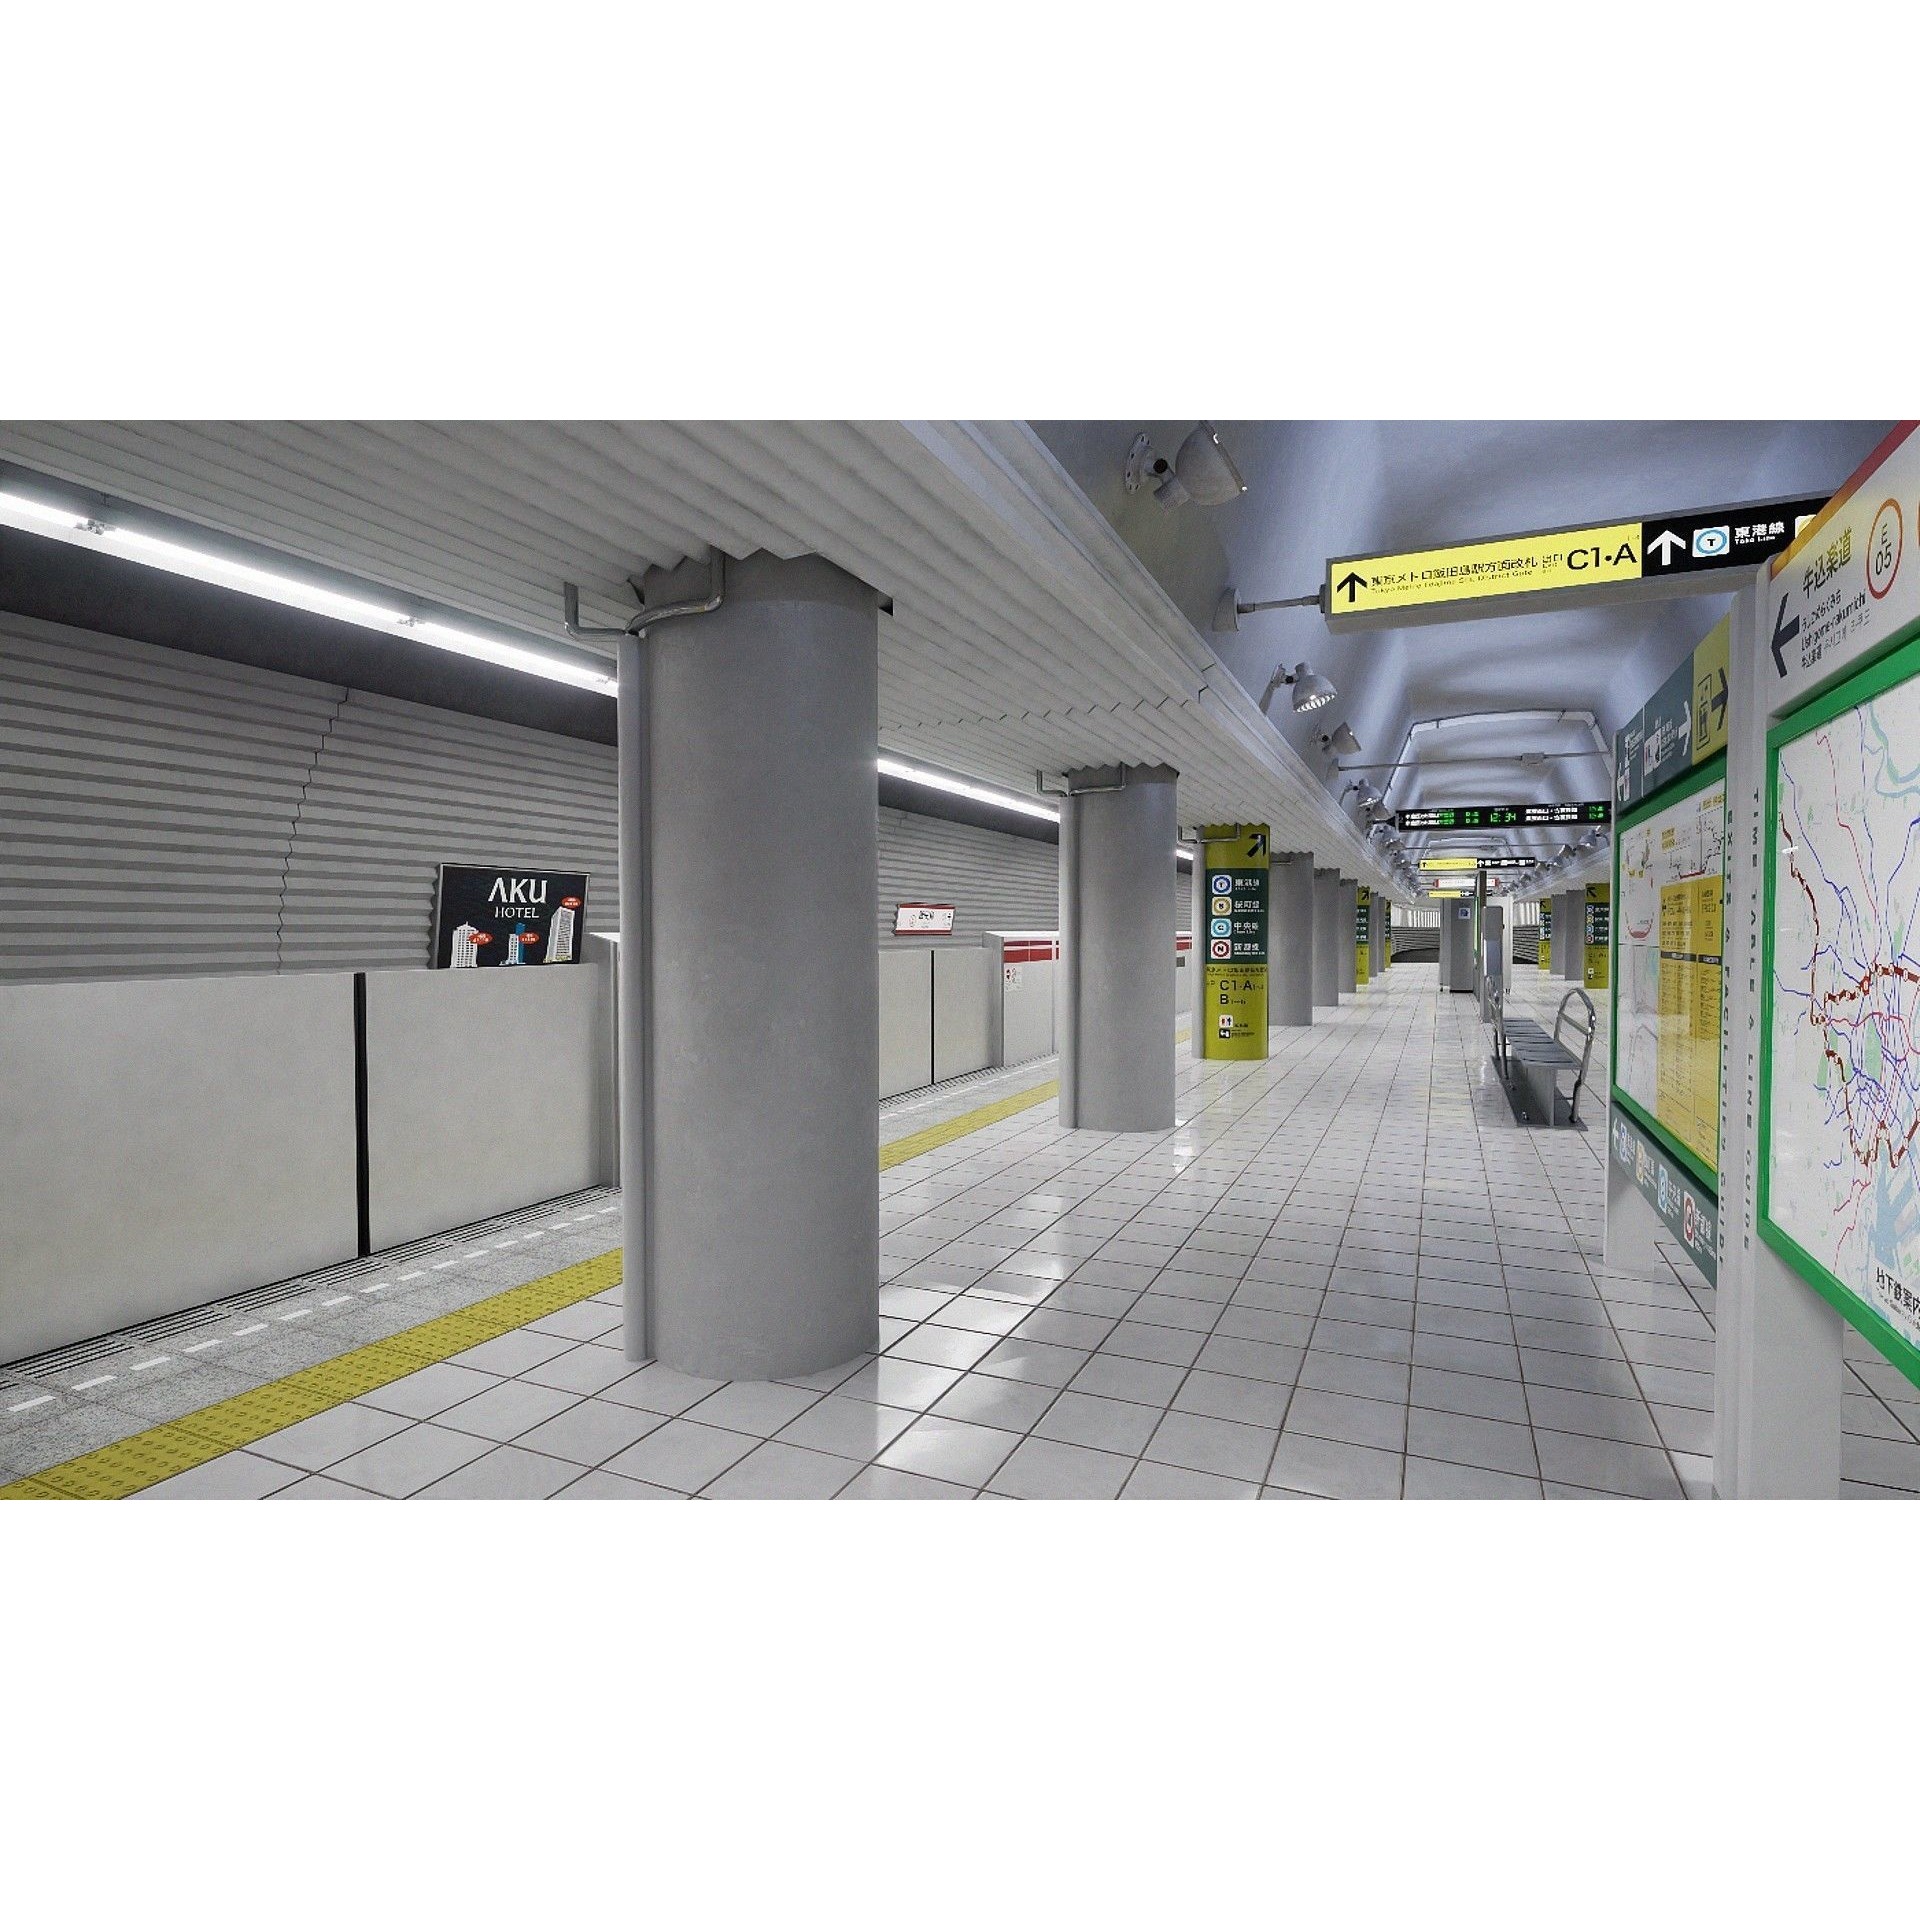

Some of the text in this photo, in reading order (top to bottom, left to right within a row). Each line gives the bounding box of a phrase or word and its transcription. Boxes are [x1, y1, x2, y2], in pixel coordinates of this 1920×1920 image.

[1706, 538, 1716, 547] T
[1881, 523, 1888, 545] E
[1875, 543, 1892, 576] 05
[1489, 812, 1517, 823] 12:34
[1751, 786, 1759, 868] TIME
[494, 906, 540, 919] HOTEL
[1748, 888, 1758, 993] TABLE
[1219, 993, 1230, 1005] B
[1744, 1149, 1752, 1252] GUIDE
